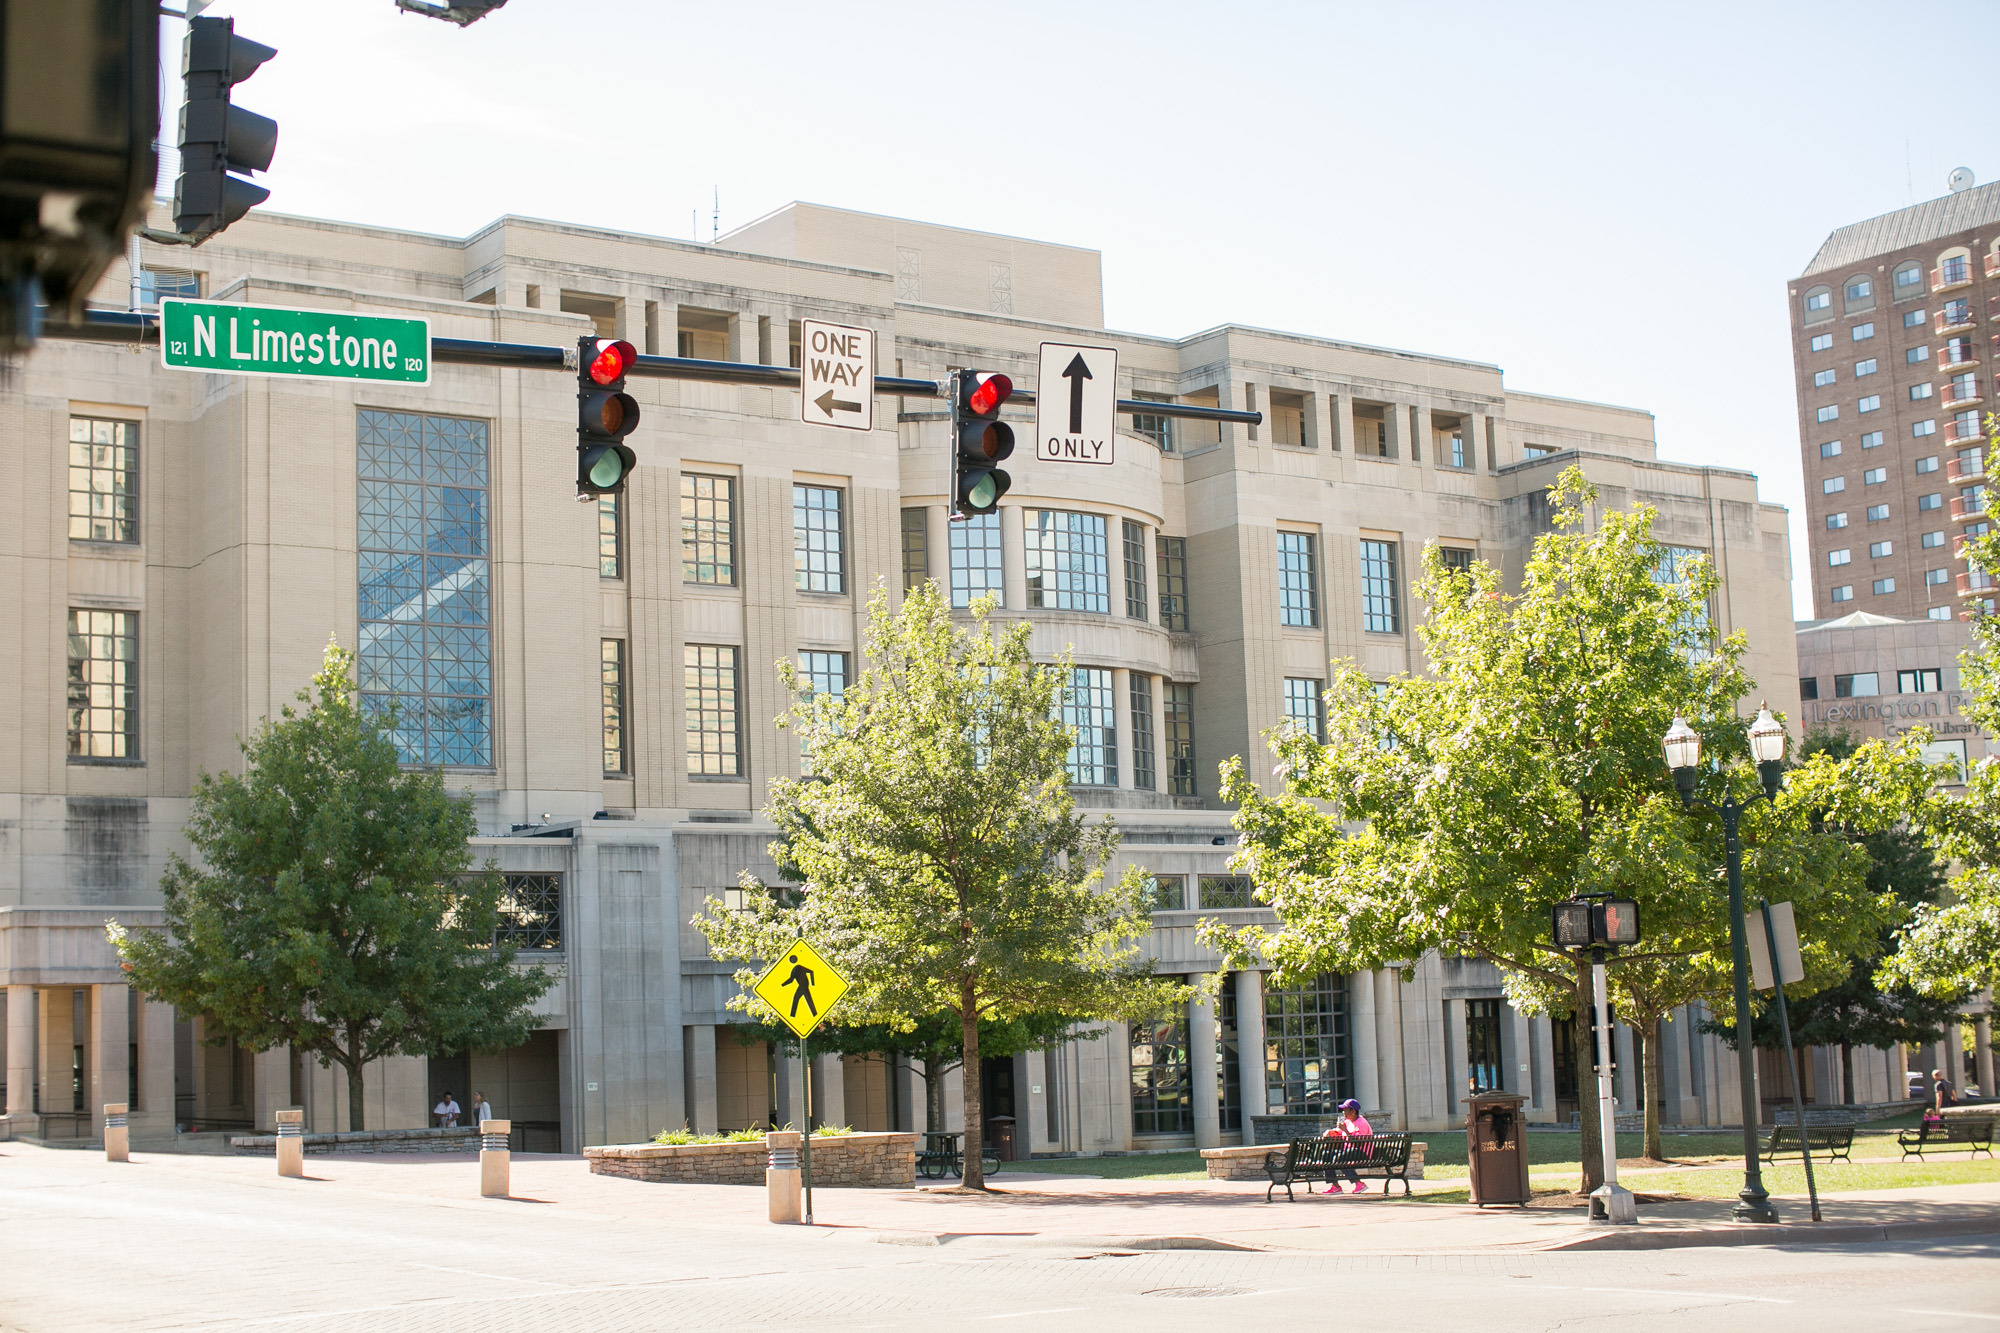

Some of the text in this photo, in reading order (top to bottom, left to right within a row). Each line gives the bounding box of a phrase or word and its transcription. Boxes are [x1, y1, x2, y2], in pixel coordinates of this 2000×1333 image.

[170, 340, 187, 356] 121
[193, 314, 398, 370] N Limestone
[811, 330, 862, 360] ONE
[404, 357, 423, 372] 120
[810, 358, 864, 387] WAY
[1048, 437, 1103, 460] ONLY
[1812, 699, 1941, 724] Lexington
[1937, 721, 1980, 736] Library
